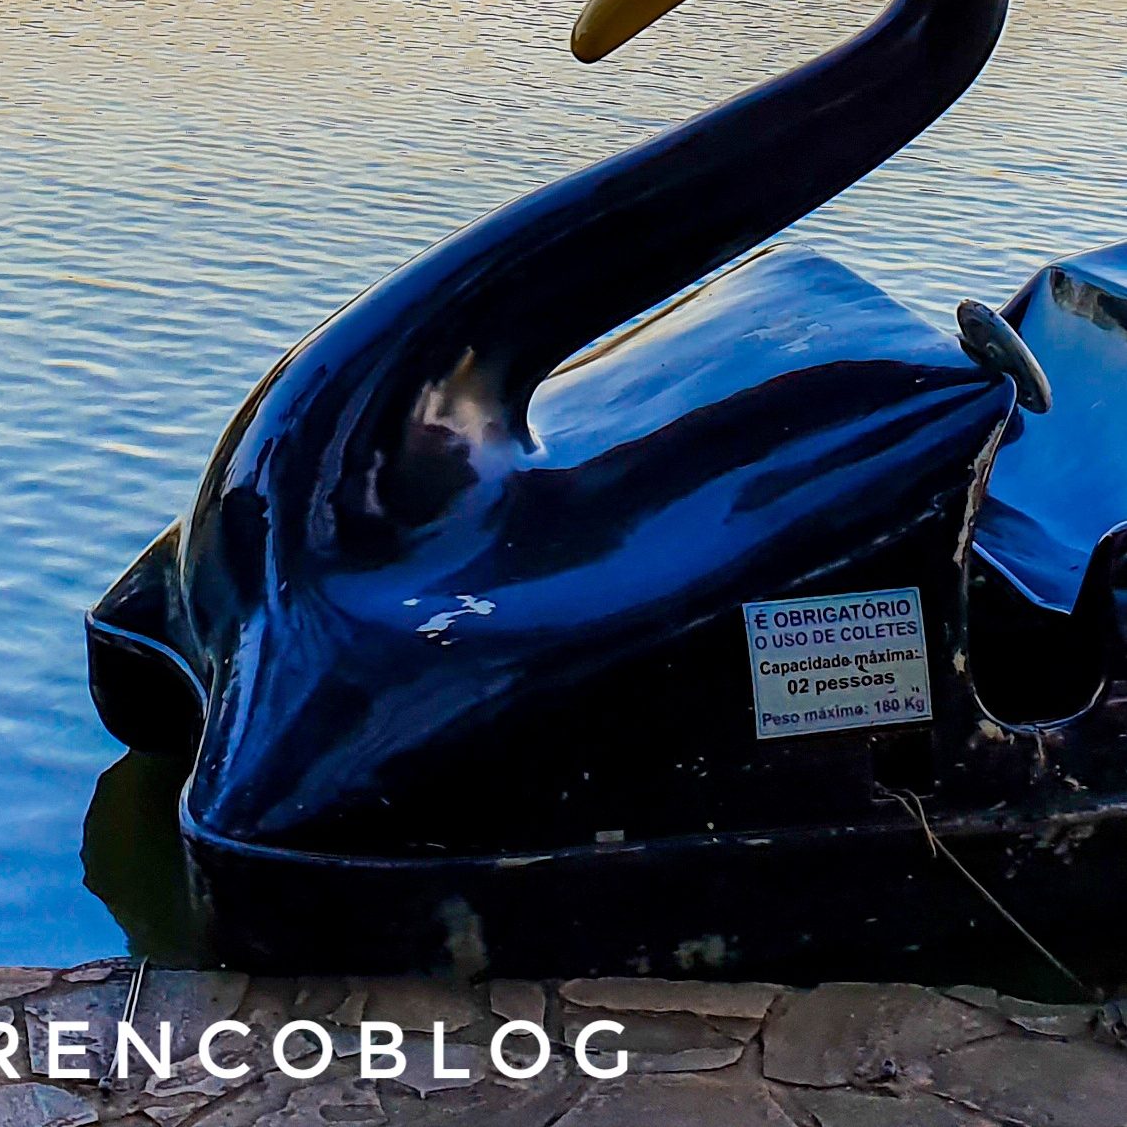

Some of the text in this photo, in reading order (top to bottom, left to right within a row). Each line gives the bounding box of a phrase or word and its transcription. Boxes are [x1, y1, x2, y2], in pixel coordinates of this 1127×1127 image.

[755, 598, 911, 630] É OBRIGATÓRIO
[755, 621, 918, 650] O USO DE COLETES
[760, 648, 919, 677] Capacidade máxima:
[787, 672, 895, 696] 02 pessoas
[762, 712, 800, 727] Peso
[874, 698, 900, 714] 180
[905, 697, 925, 713] Kg
